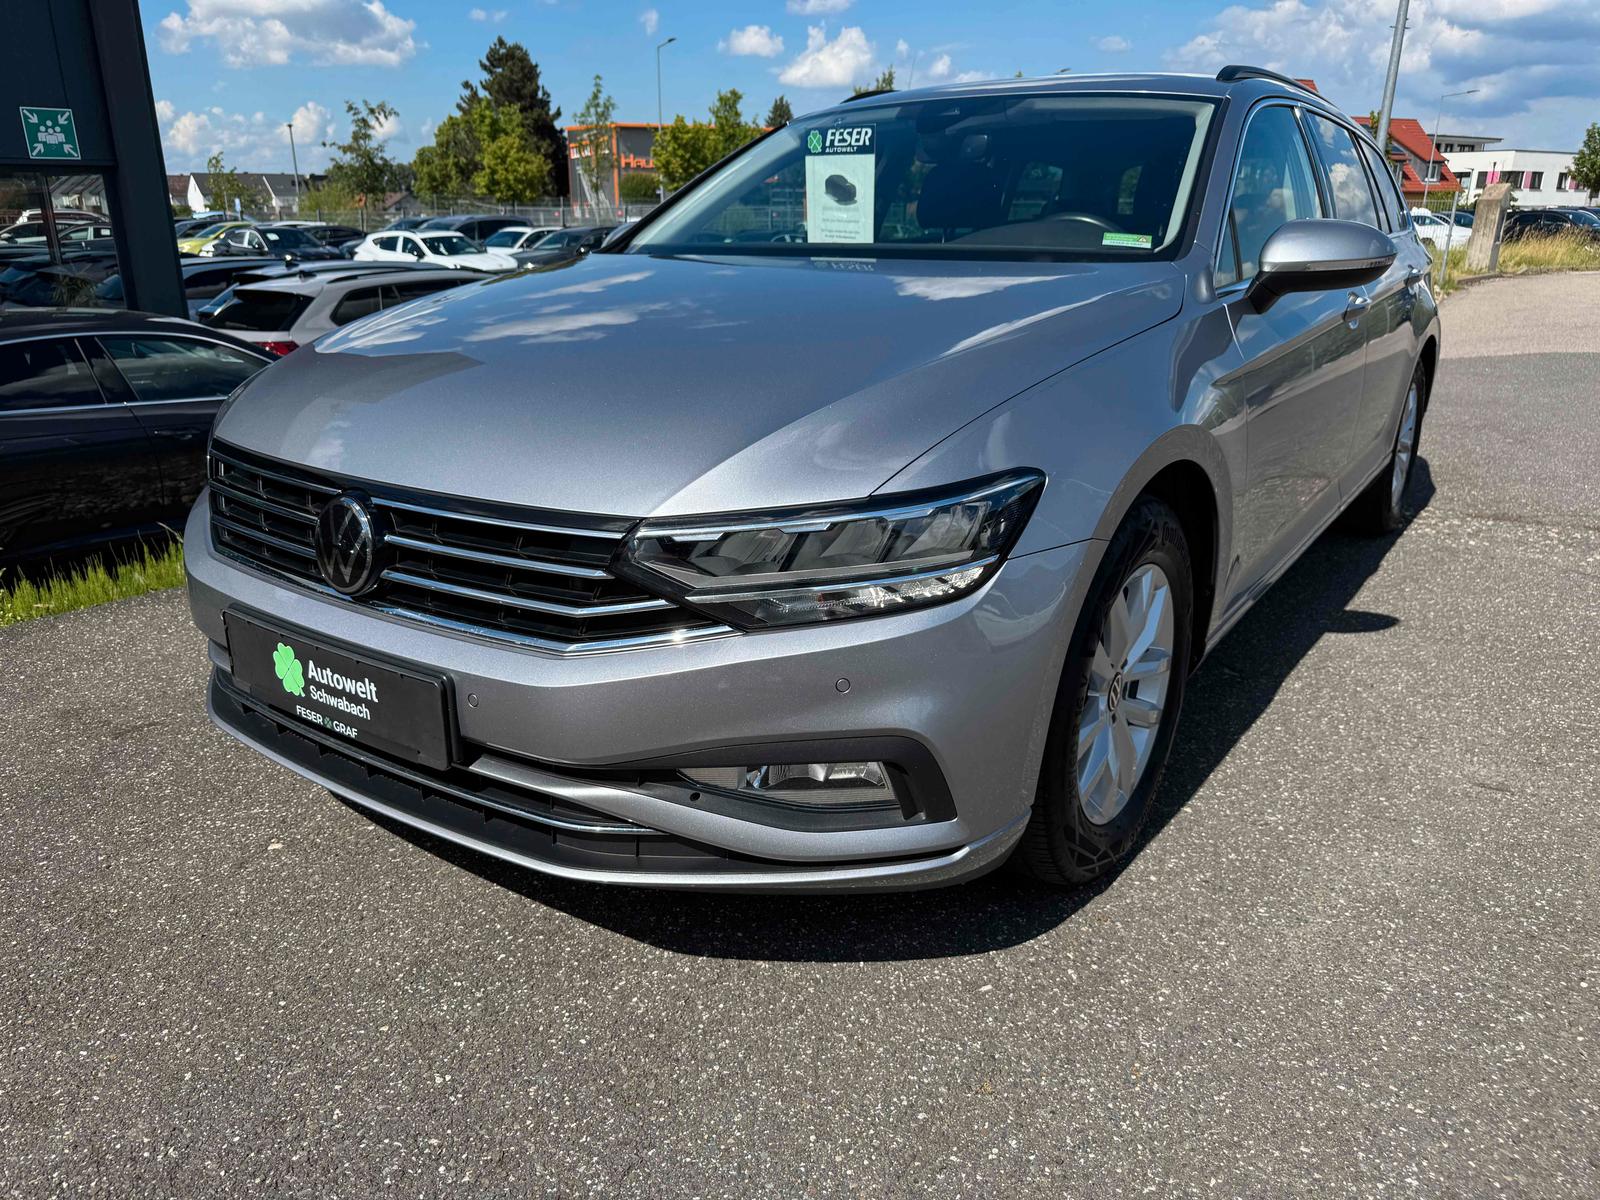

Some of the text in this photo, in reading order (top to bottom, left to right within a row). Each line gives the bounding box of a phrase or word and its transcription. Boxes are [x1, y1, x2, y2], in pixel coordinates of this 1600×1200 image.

[825, 128, 872, 147] FESER
[621, 153, 656, 168] HAU
[308, 660, 379, 703] Autowelt
[309, 685, 371, 720] Schwabach
[296, 705, 358, 739] FESER GRAF
